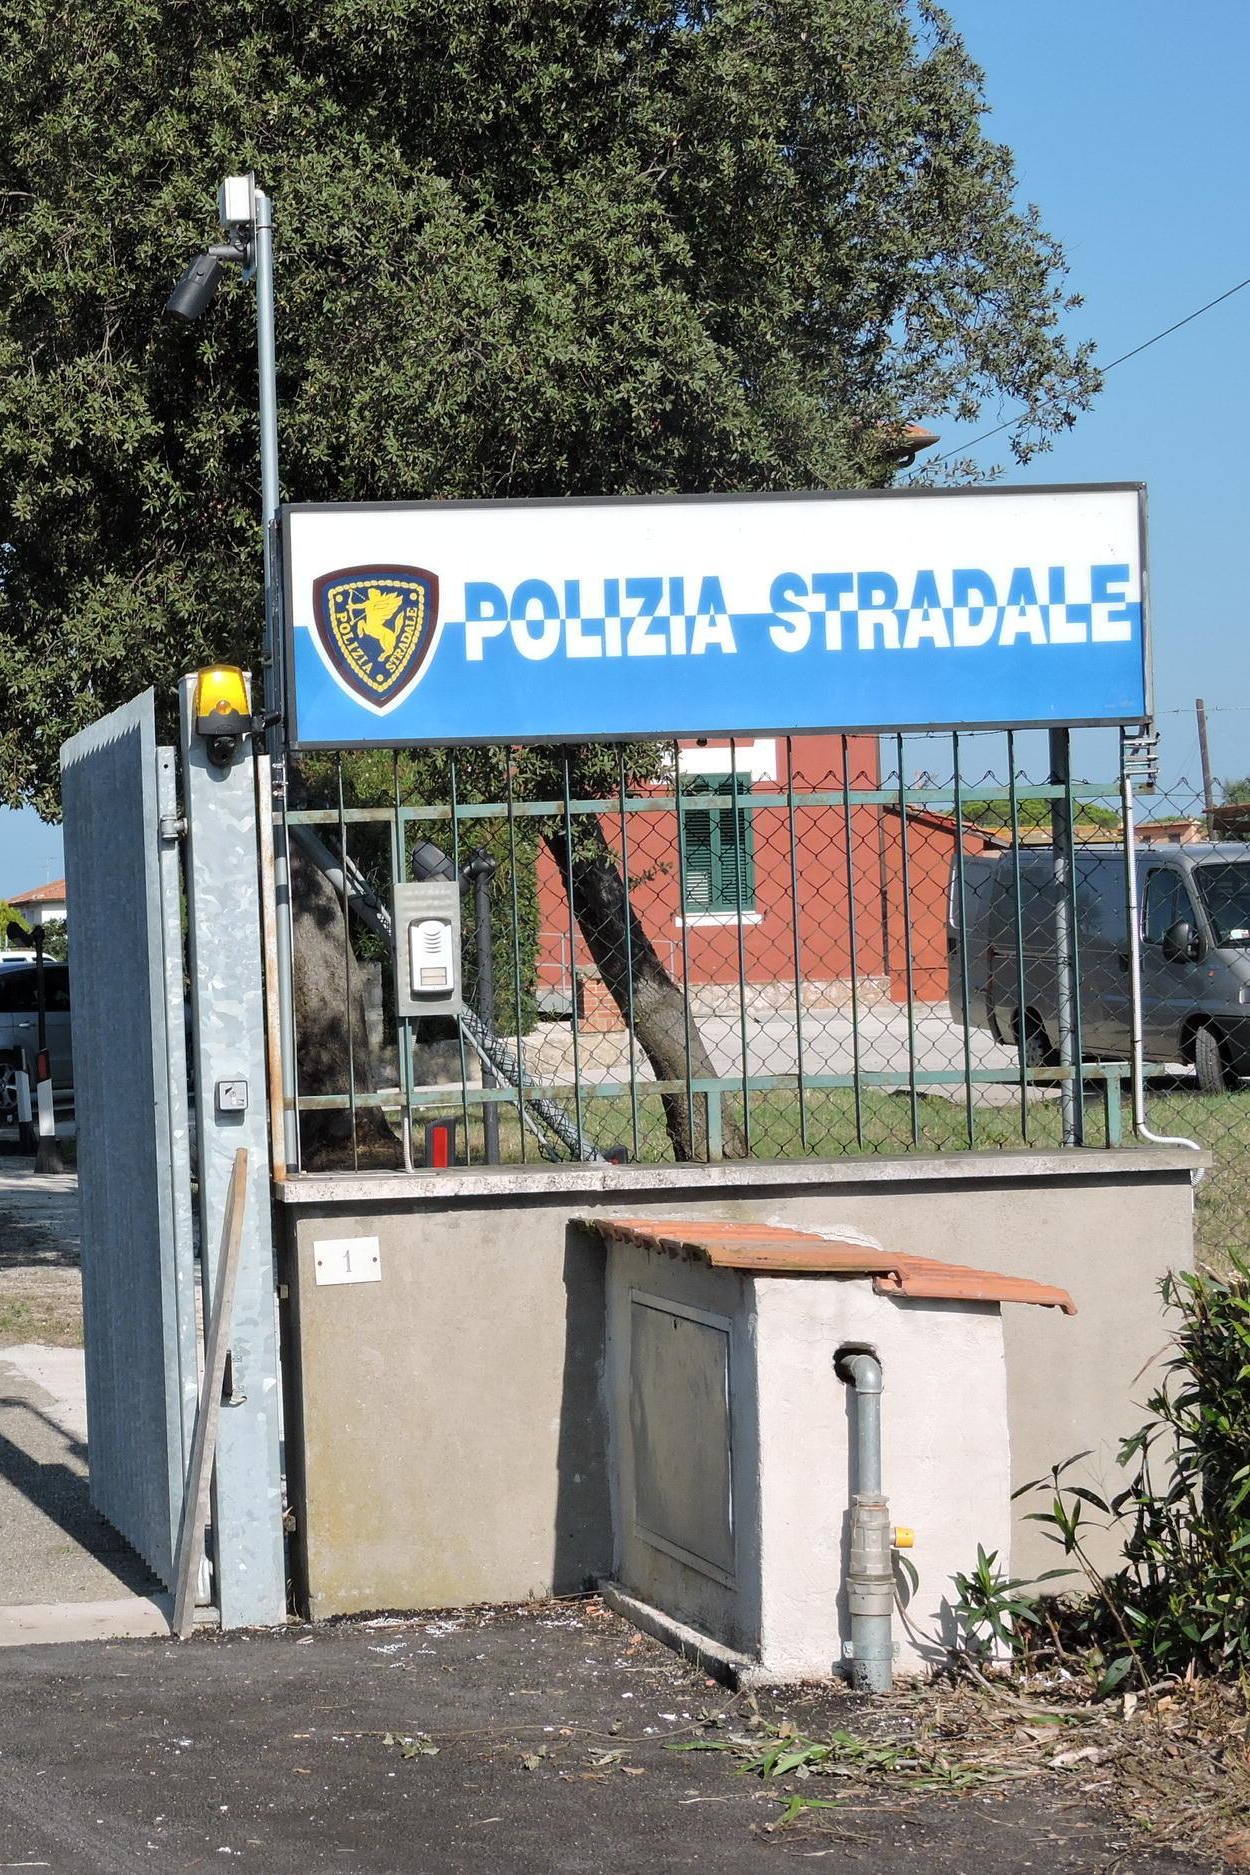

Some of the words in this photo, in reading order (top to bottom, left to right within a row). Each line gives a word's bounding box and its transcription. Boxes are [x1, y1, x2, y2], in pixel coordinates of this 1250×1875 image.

[336, 610, 373, 674] POLIZIA
[385, 607, 418, 673] STRADALE
[464, 576, 738, 660] POLIZIA
[769, 564, 1132, 652] STRADALE
[343, 1249, 352, 1272] 1
